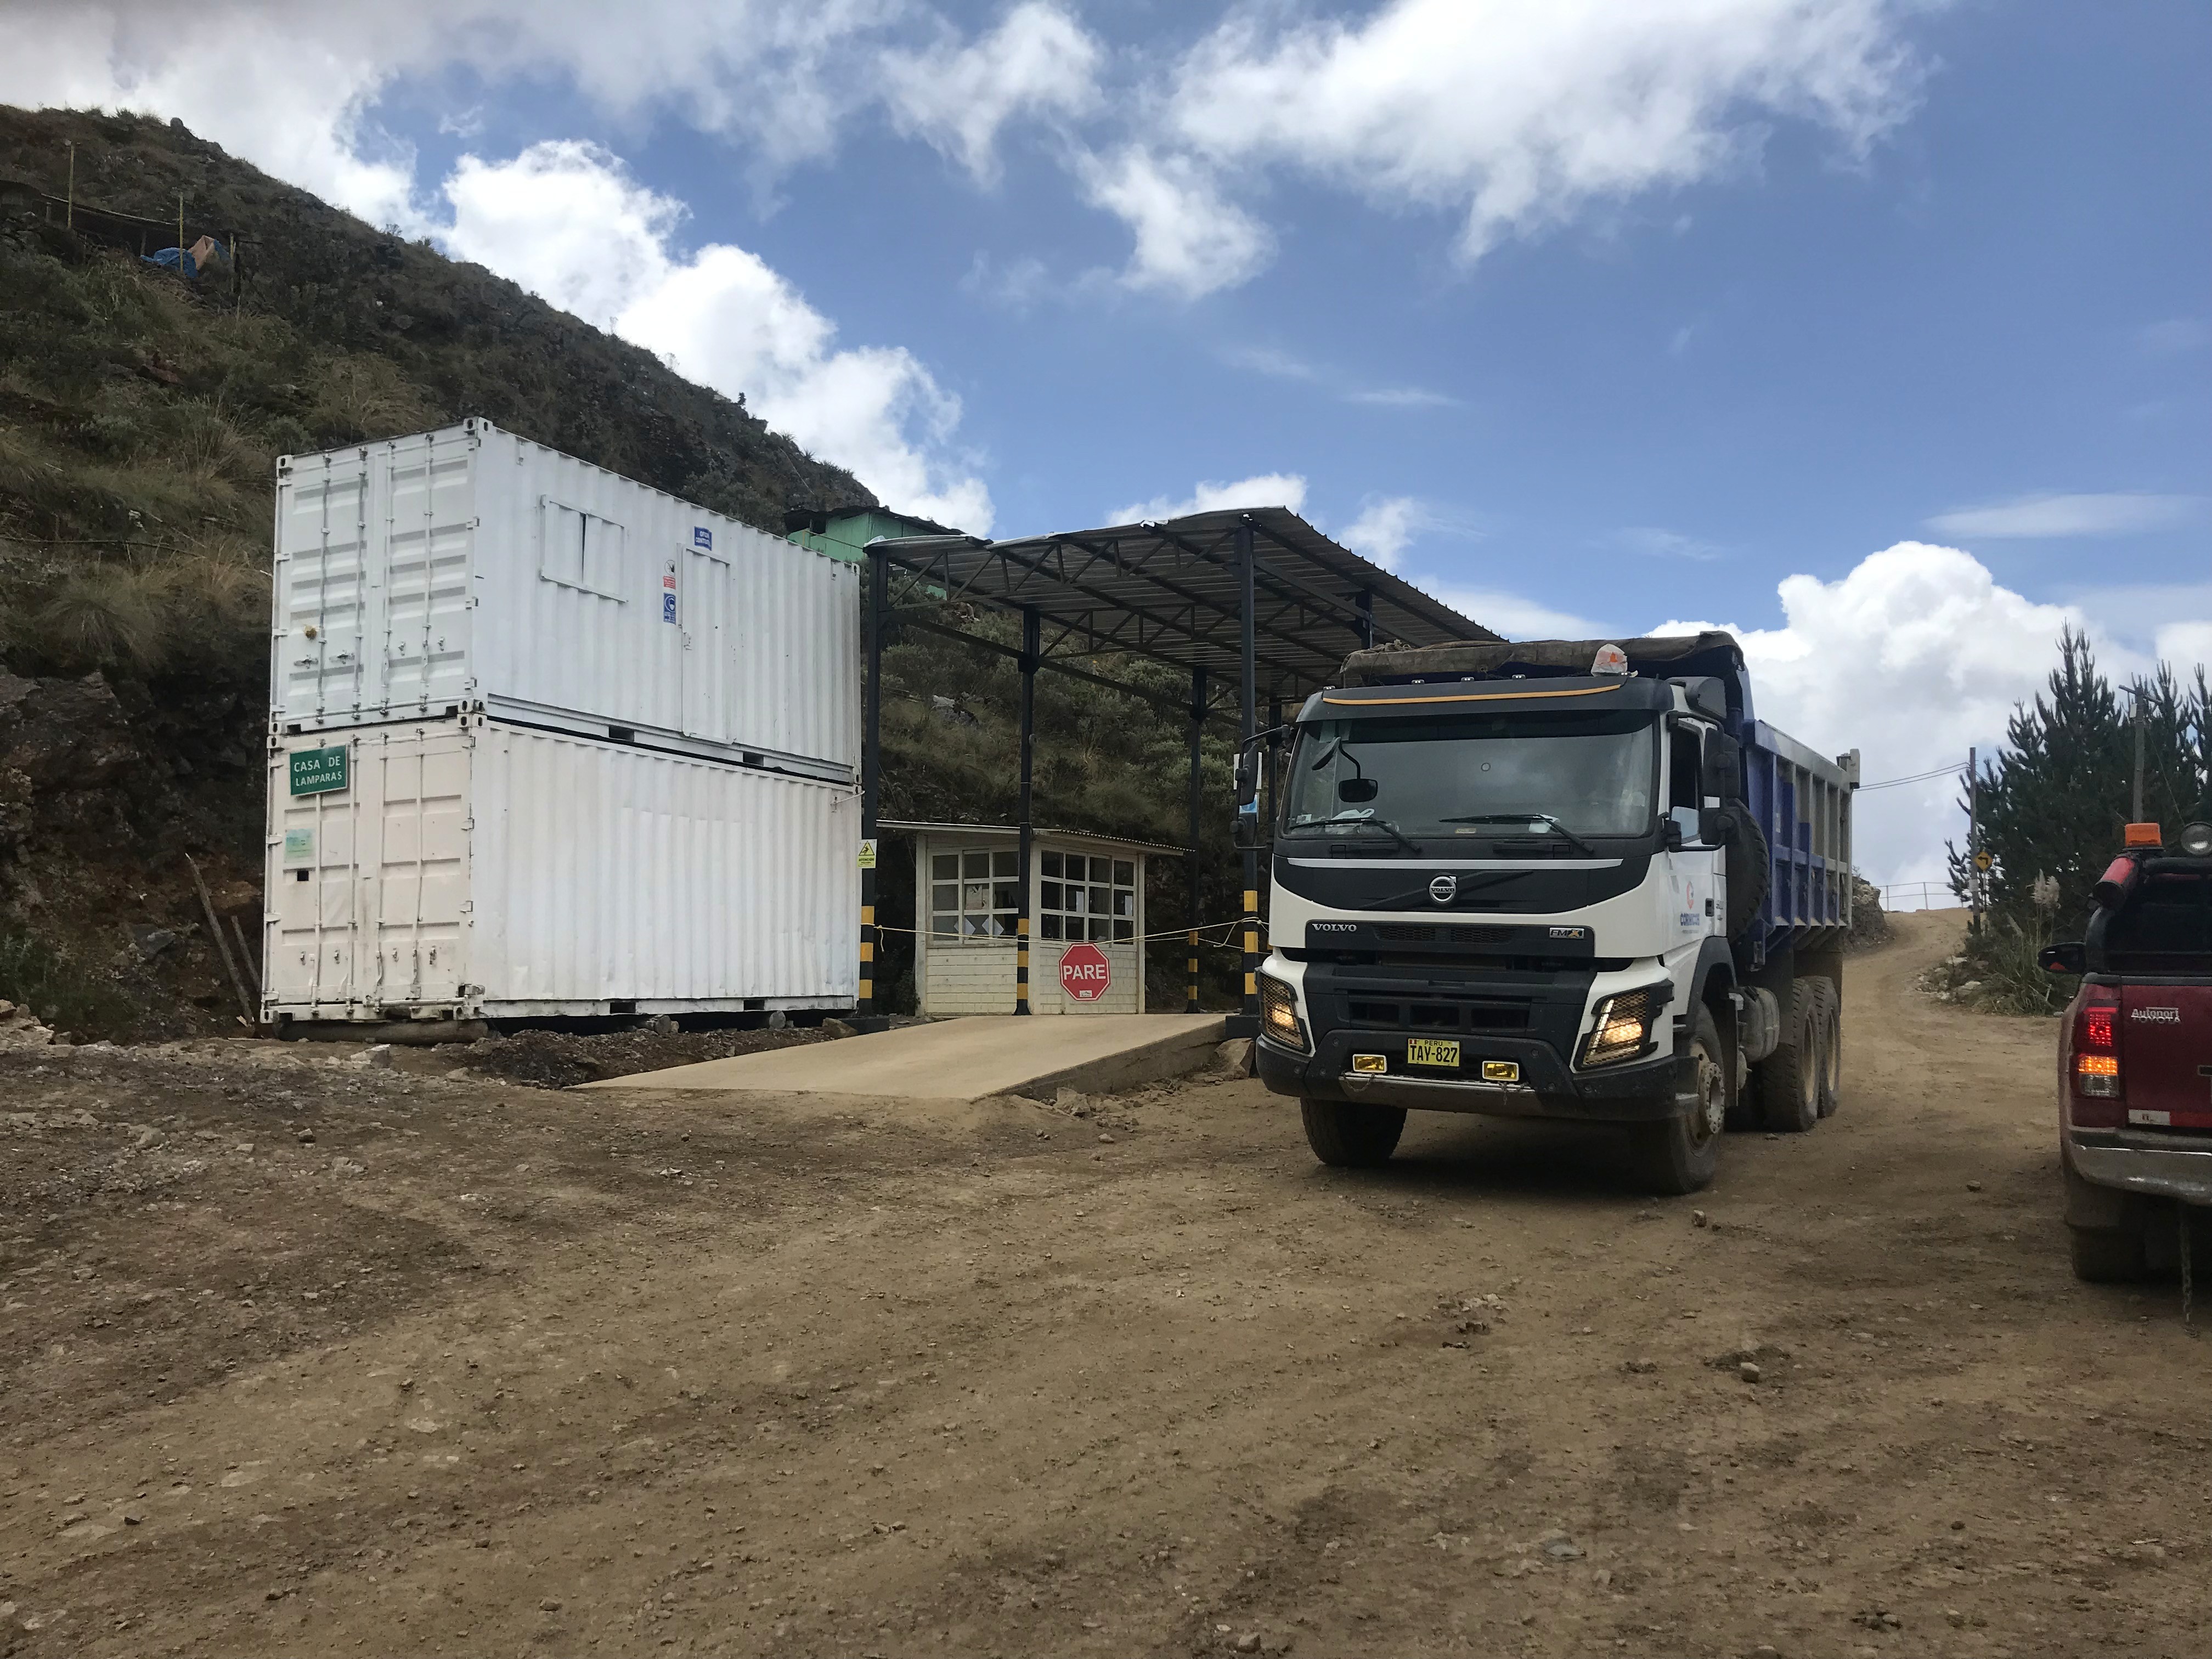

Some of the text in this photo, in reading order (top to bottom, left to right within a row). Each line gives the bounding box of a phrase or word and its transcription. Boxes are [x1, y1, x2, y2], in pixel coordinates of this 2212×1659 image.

[294, 756, 341, 772] CASA DE
[296, 771, 342, 787] LAMPARAS
[1312, 923, 1357, 932] VOLVO
[1550, 929, 1582, 938] FMX
[1063, 964, 1106, 980] PARE
[2131, 1007, 2180, 1018] Autonort
[1410, 1045, 1458, 1063] TAY-827
